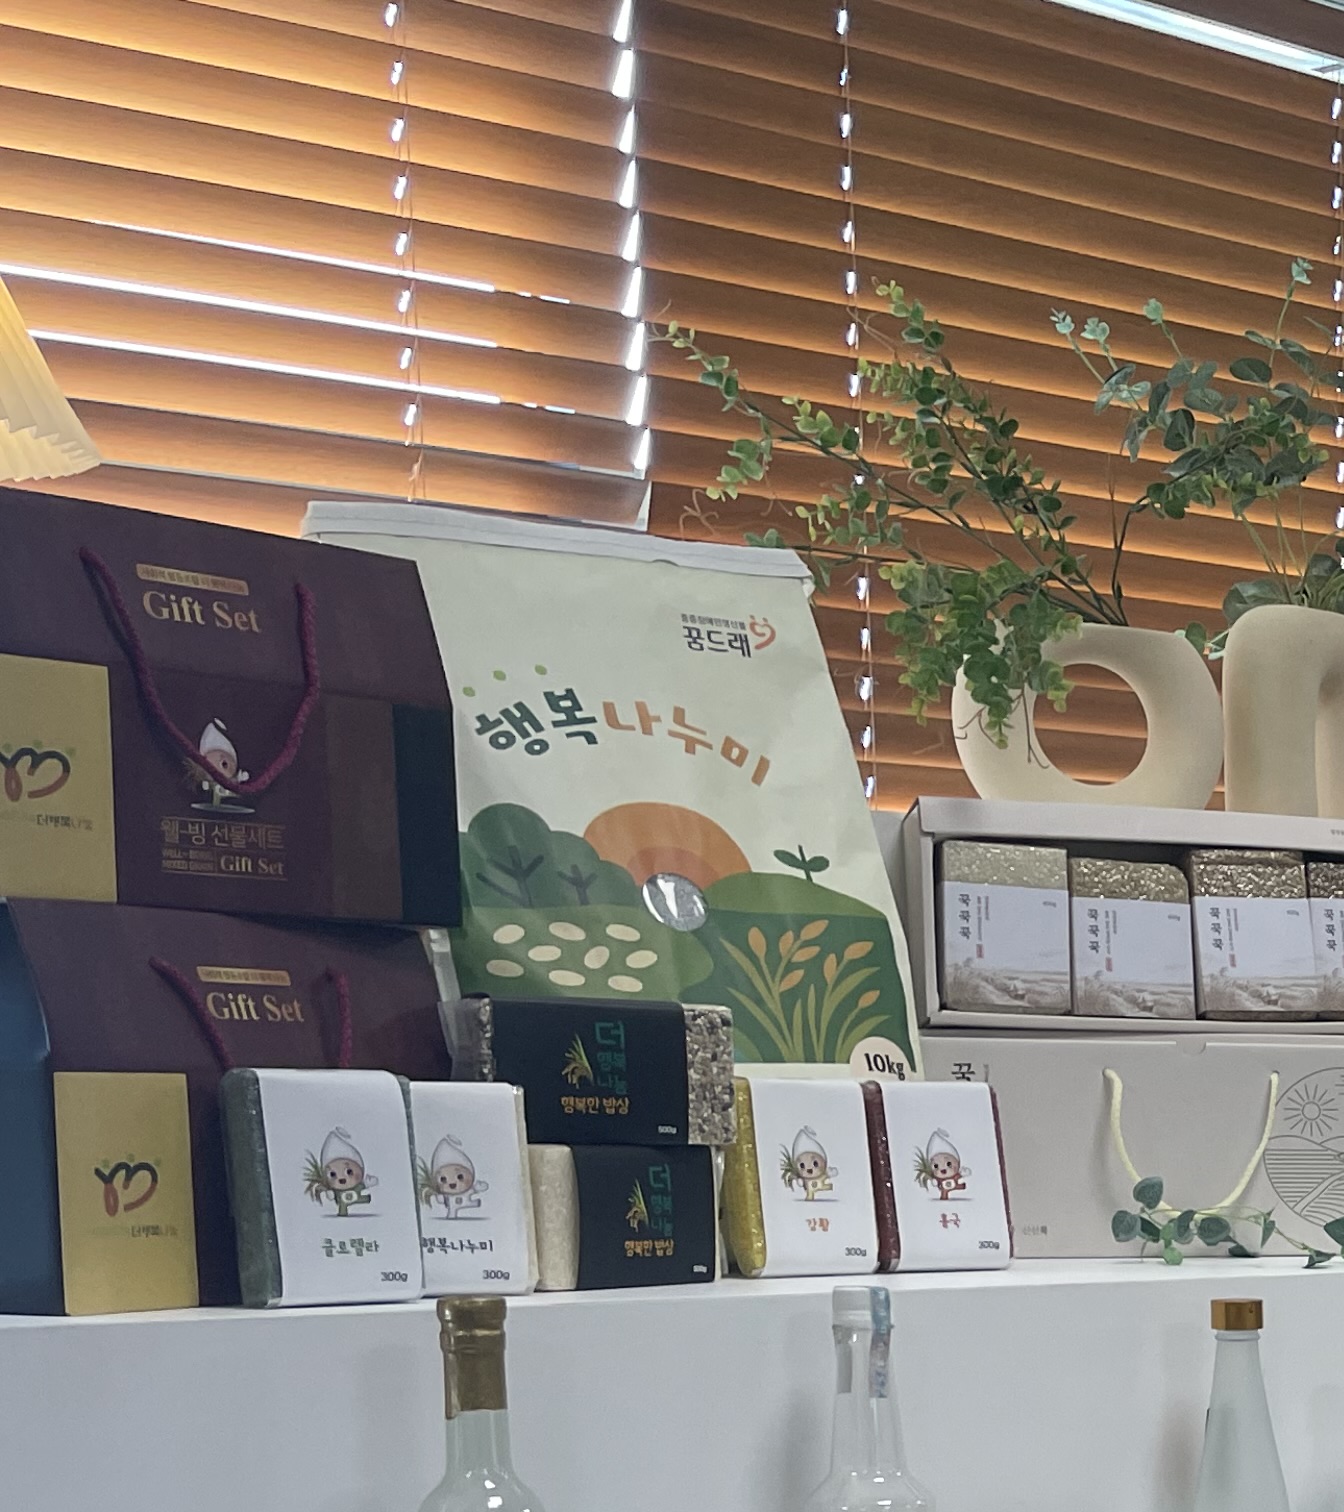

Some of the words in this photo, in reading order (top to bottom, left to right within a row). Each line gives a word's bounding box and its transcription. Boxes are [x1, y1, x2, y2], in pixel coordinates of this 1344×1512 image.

[142, 591, 205, 625] Gift
[213, 601, 262, 633] Set
[682, 626, 751, 658] 꿈드래
[220, 855, 252, 872] Gift
[258, 858, 284, 875] Set
[207, 992, 260, 1022] Gift
[263, 994, 304, 1023] Set
[864, 1052, 906, 1081] 10kg
[380, 1271, 408, 1284] 300g
[482, 1269, 510, 1282] 300g
